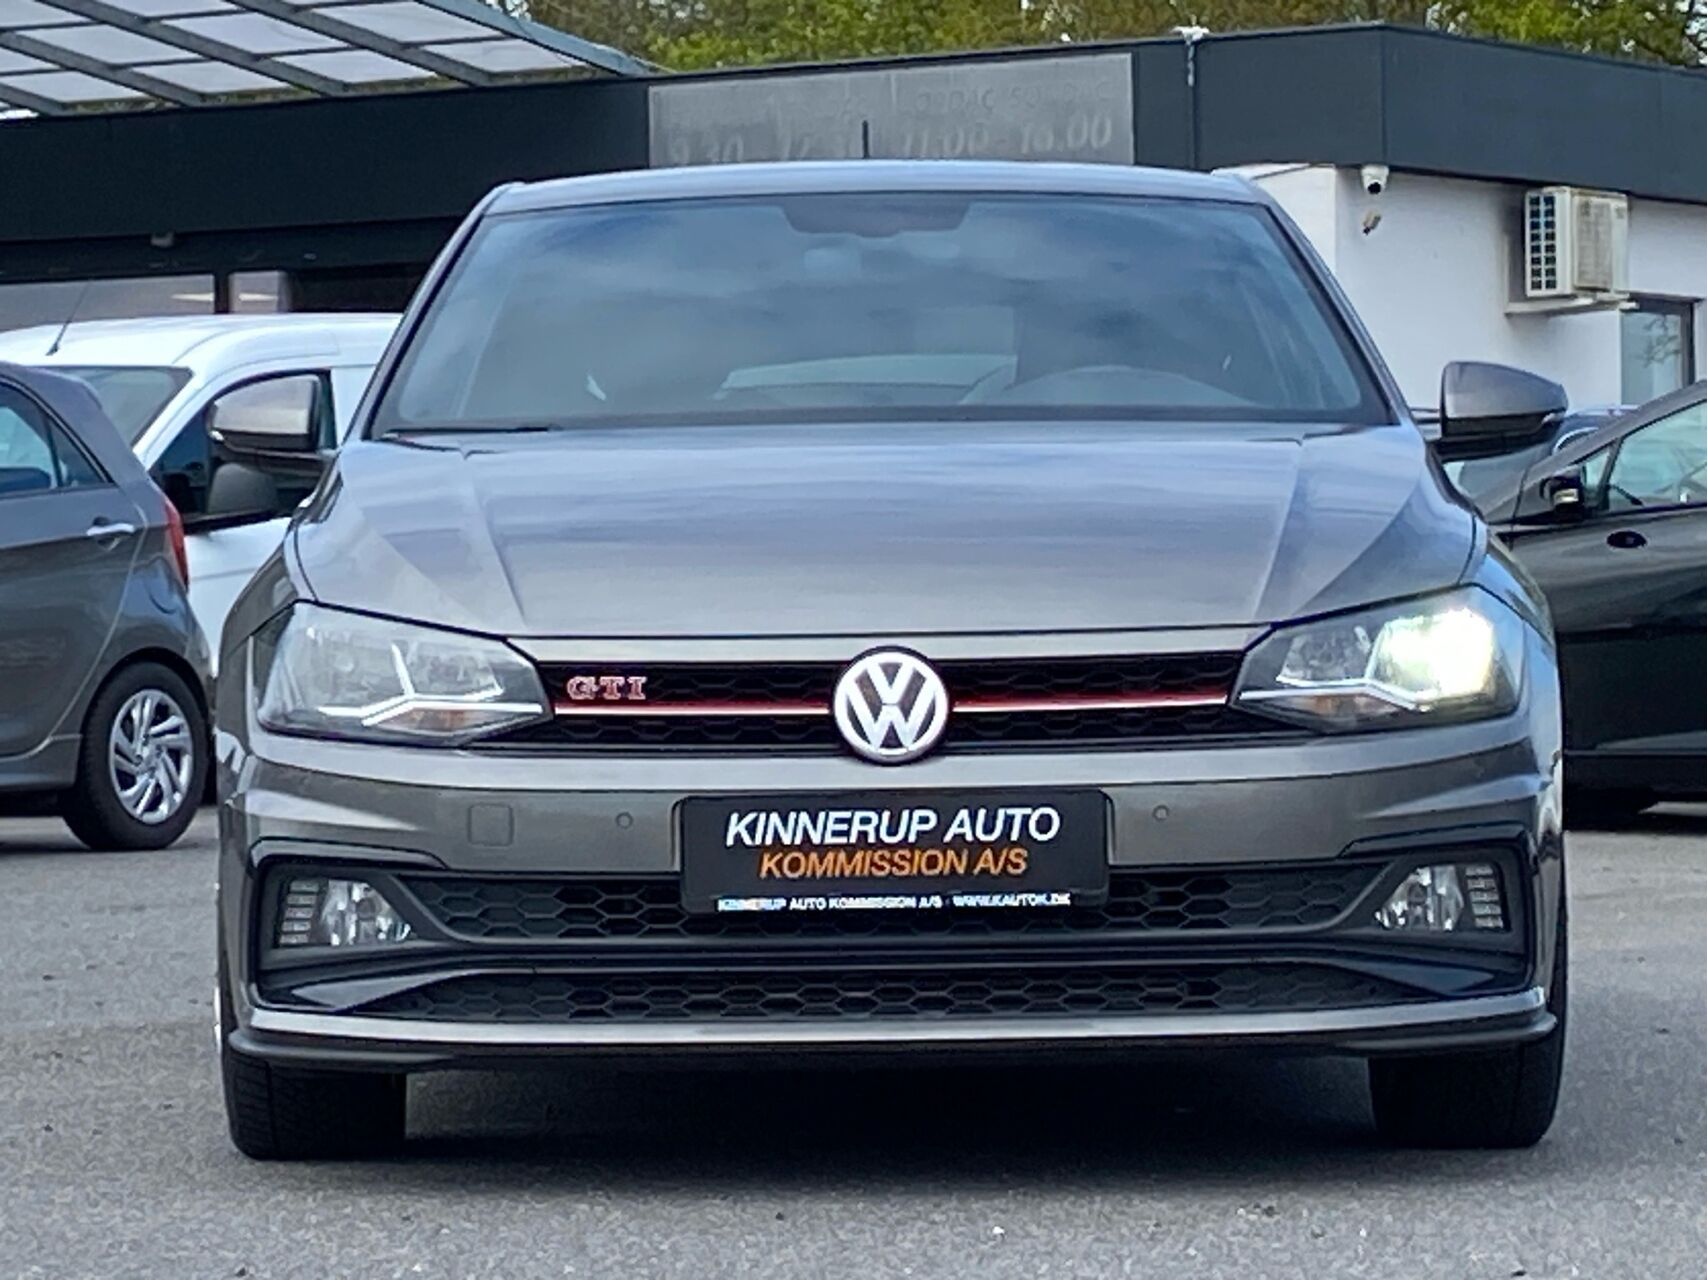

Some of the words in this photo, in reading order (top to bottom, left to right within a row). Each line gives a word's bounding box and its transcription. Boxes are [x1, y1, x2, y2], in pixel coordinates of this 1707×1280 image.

[566, 675, 648, 701] GTI
[726, 811, 936, 846] KINNERUP
[943, 807, 1061, 844] AUTO
[759, 850, 968, 878] KOMMISSION
[973, 847, 1029, 876] A/S
[788, 897, 827, 911] AUTO
[828, 896, 917, 910] KOMMISSION
[918, 895, 943, 909] A/S
